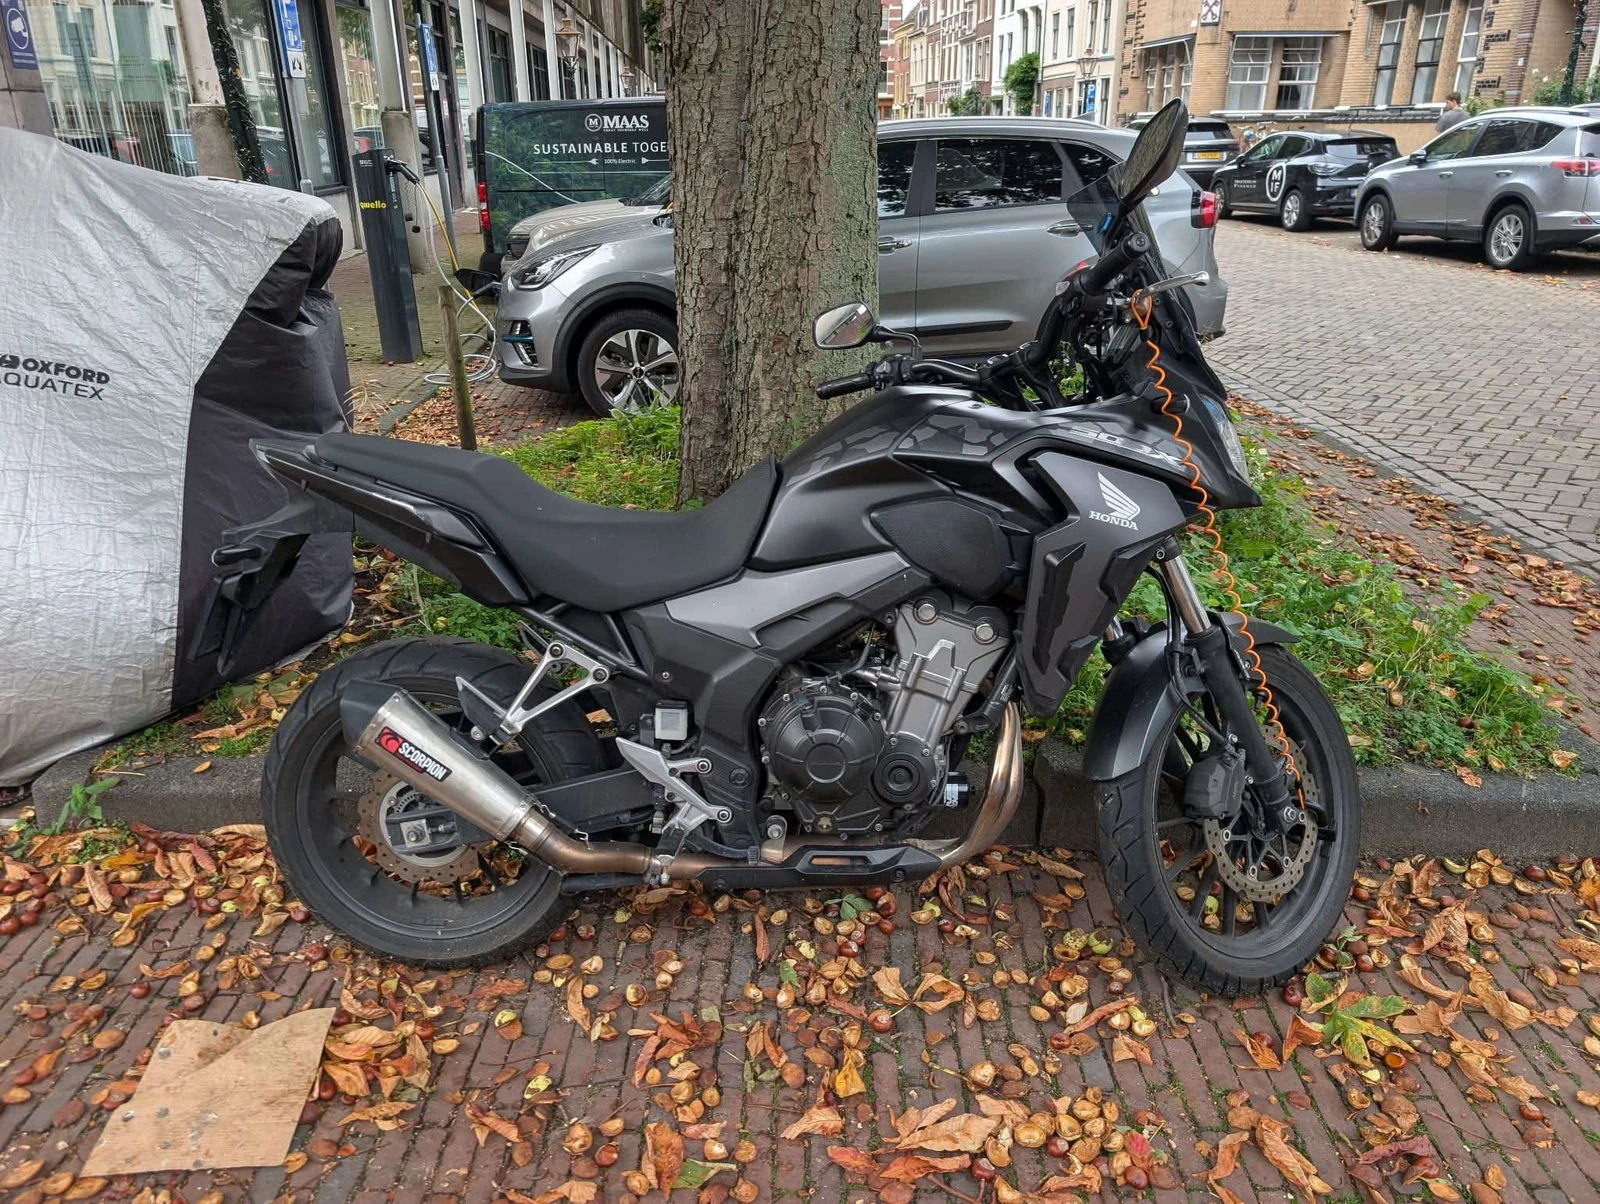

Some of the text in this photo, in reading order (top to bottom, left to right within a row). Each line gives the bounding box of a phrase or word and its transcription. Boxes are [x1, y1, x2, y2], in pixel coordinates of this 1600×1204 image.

[602, 114, 650, 129] MAAS
[533, 141, 667, 155] SUSTAINABLE TOGE
[1271, 169, 1282, 181] M
[1270, 181, 1281, 193] IF
[360, 200, 387, 210] qwello
[22, 358, 110, 385] OXFORD
[0, 372, 104, 401] QUATEX
[1088, 510, 1139, 531] HONDA
[398, 742, 447, 780] SCORPION
